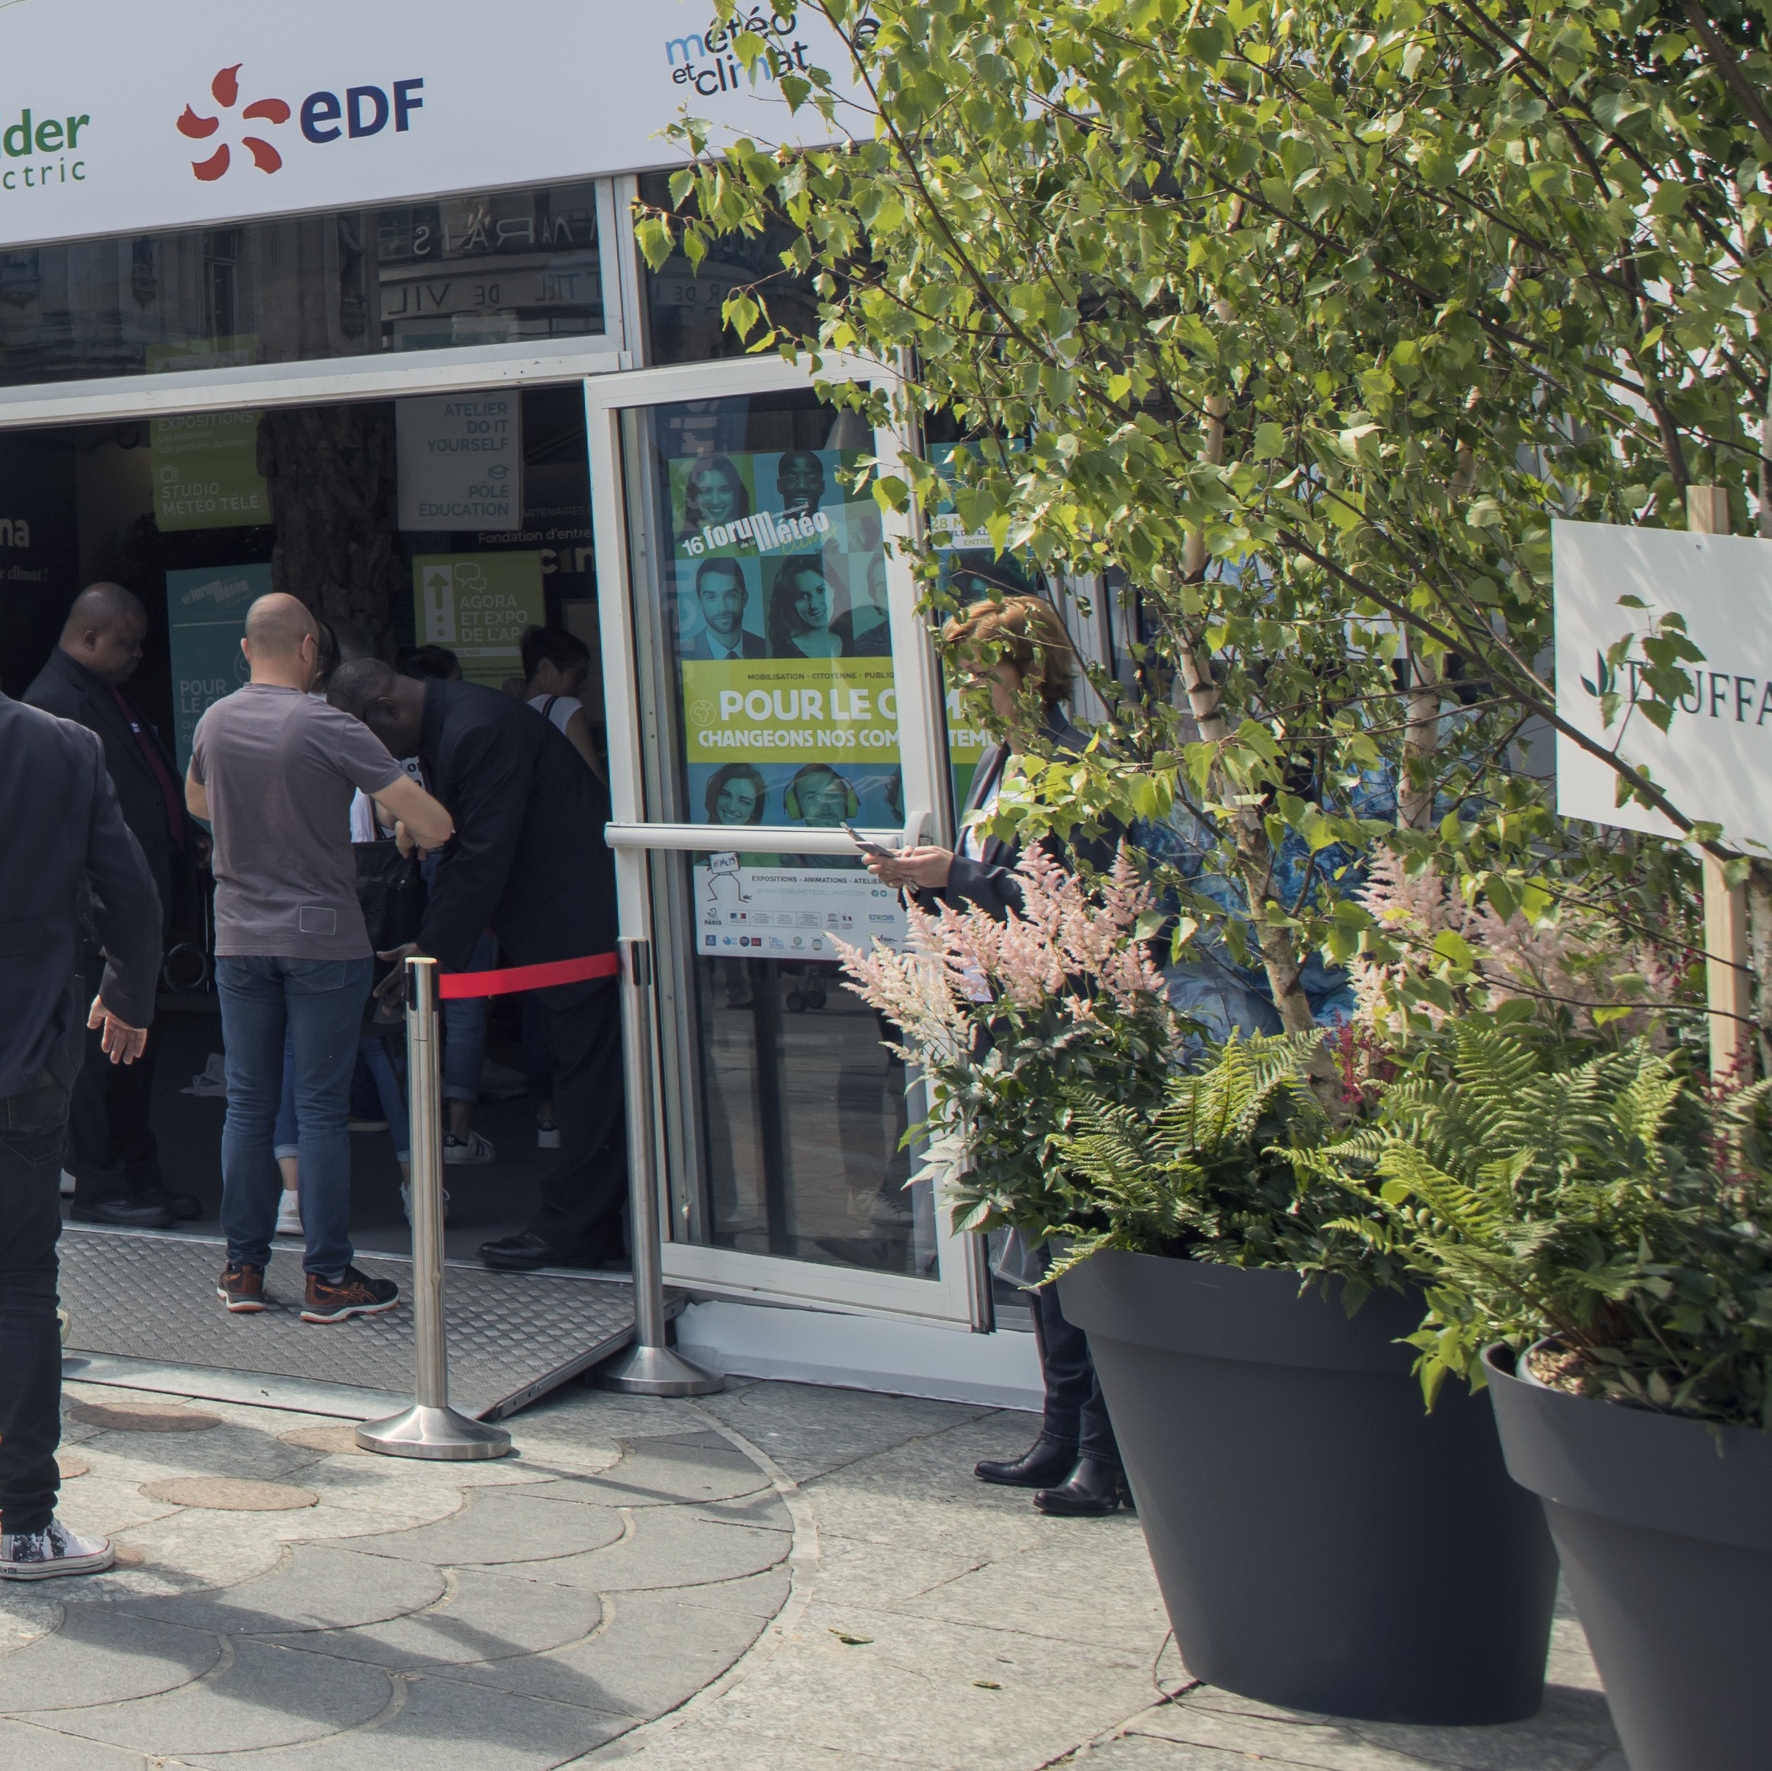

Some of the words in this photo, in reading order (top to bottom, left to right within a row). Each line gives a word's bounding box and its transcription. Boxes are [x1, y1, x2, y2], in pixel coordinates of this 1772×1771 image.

[665, 6, 797, 66] météo
[672, 62, 697, 84] et
[444, 401, 508, 418] ATELIER
[158, 411, 255, 432] EXPOSITIONS
[467, 420, 490, 435] DO
[494, 419, 509, 434] IT
[427, 437, 509, 453] YOURSELF
[162, 482, 219, 499] STUDIO
[469, 481, 509, 499] PÔLE
[163, 496, 216, 515] MÉTÉO
[219, 492, 259, 510] TÉLÉ
[419, 499, 509, 518] ÉDUCATION
[478, 530, 544, 545] Fondation
[7, 565, 41, 582] climat
[461, 594, 517, 609] AGORA
[461, 611, 479, 626] ET
[484, 609, 529, 625] EXPO
[462, 627, 482, 642] DE
[747, 673, 805, 681] MOBILISATION
[811, 671, 857, 680] CITOYENNE
[179, 678, 226, 696] POUR
[181, 697, 201, 714] LE
[719, 689, 823, 721] POUR
[830, 687, 872, 720] LE
[698, 730, 814, 748] CHANGEONS
[817, 729, 856, 747] NOS
[751, 874, 798, 883] EXPOSITIONS
